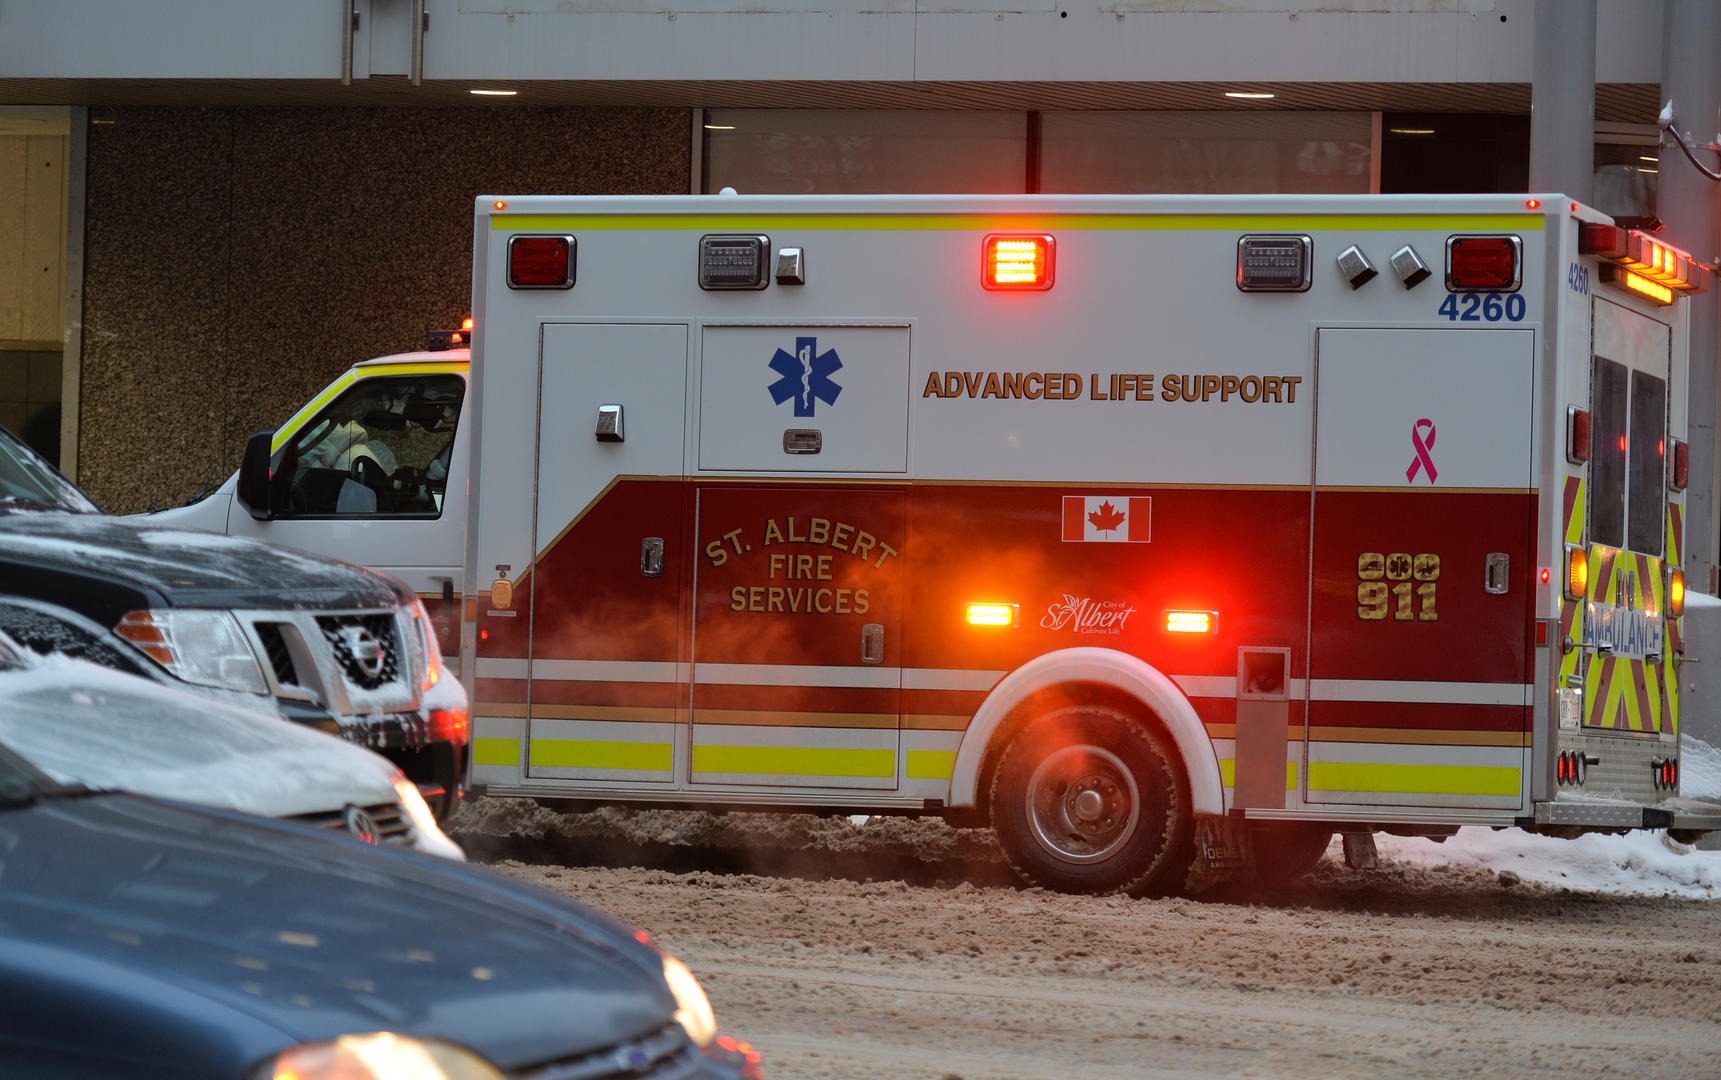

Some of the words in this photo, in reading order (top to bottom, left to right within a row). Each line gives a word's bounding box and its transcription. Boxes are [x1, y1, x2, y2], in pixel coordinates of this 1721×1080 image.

[1568, 262, 1588, 296] 4260
[1438, 293, 1526, 322] 4260
[923, 371, 1083, 400] ADVANCED
[1090, 374, 1154, 401] LIFE
[1161, 375, 1302, 403] SUPPORT
[705, 528, 751, 567] ST.
[763, 516, 899, 569] ALBERT
[768, 553, 833, 580] FIRE
[729, 585, 870, 615] SERVICES
[1102, 600, 1118, 609] City
[1118, 600, 1127, 608] of
[1357, 581, 1439, 620] 911
[1108, 627, 1121, 635] Life
